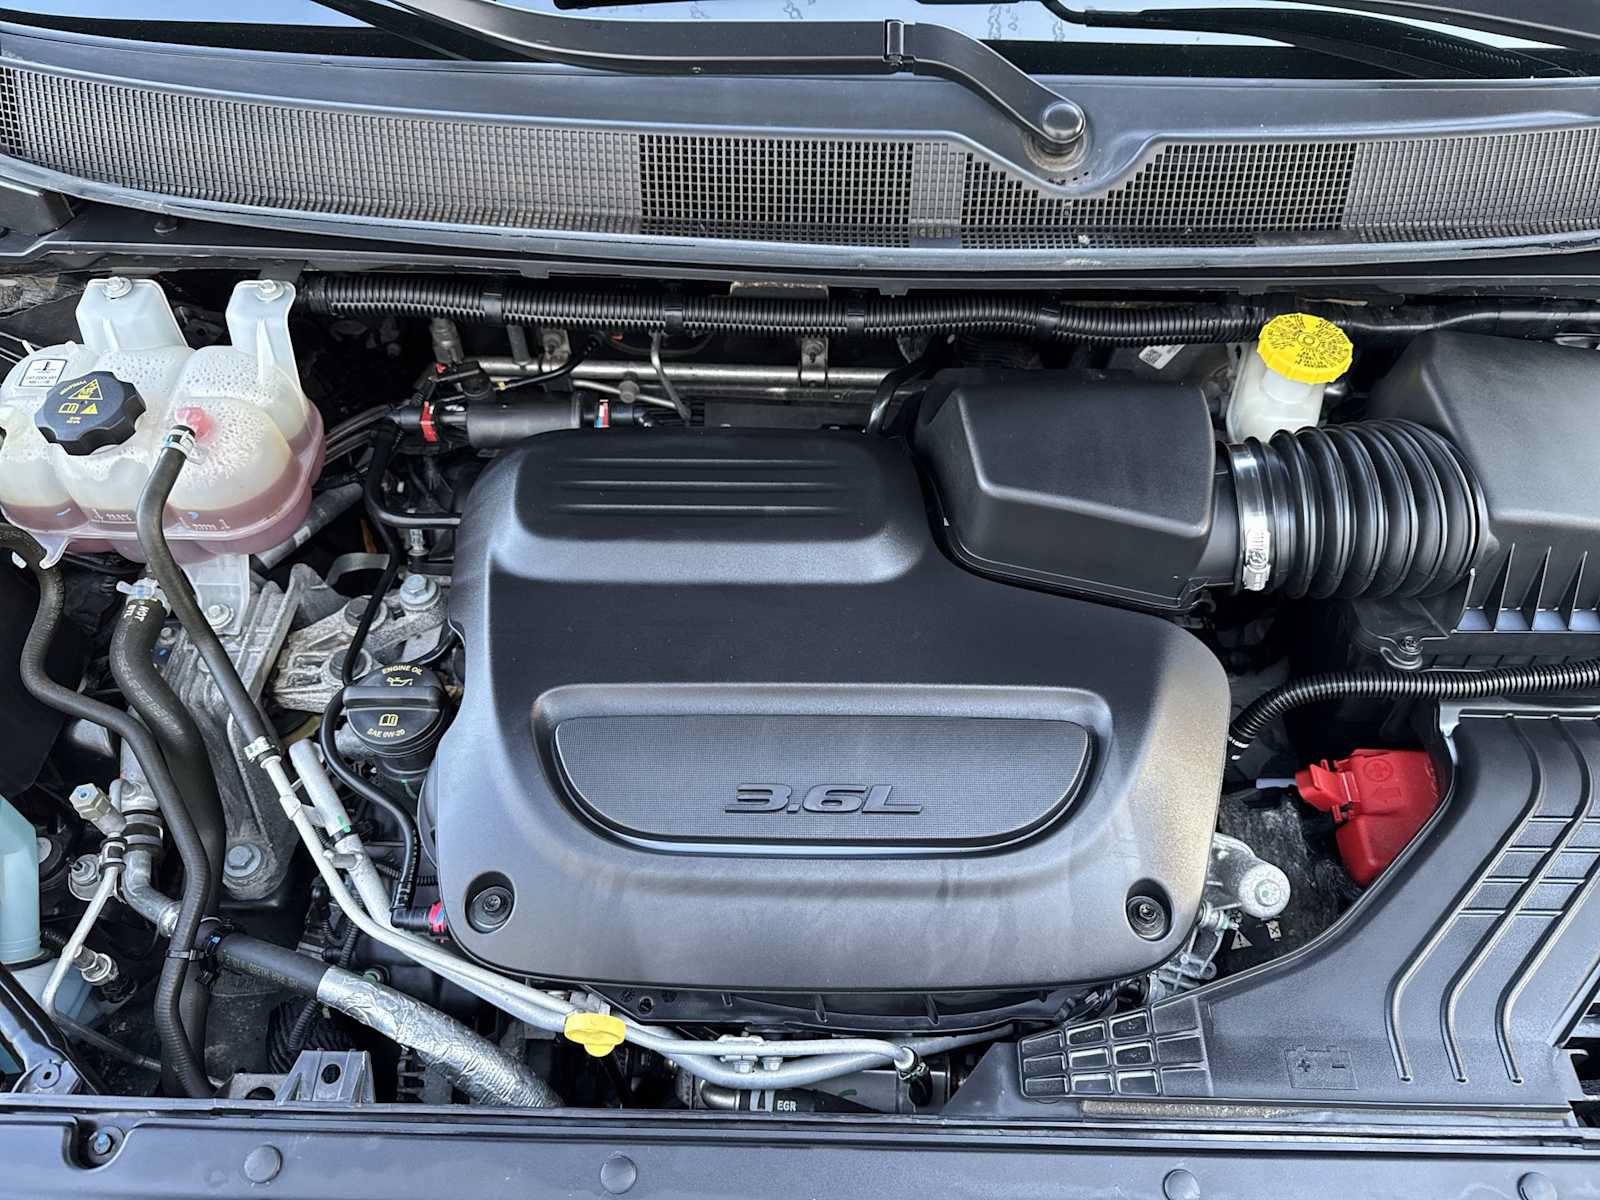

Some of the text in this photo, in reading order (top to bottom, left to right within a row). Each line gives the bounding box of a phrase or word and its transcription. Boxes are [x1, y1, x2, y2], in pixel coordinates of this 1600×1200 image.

[382, 664, 423, 676] ENGINE OIL
[367, 727, 406, 738] SAE 0W-20
[724, 782, 924, 815] 3.6L
[777, 1100, 797, 1112] EGR
